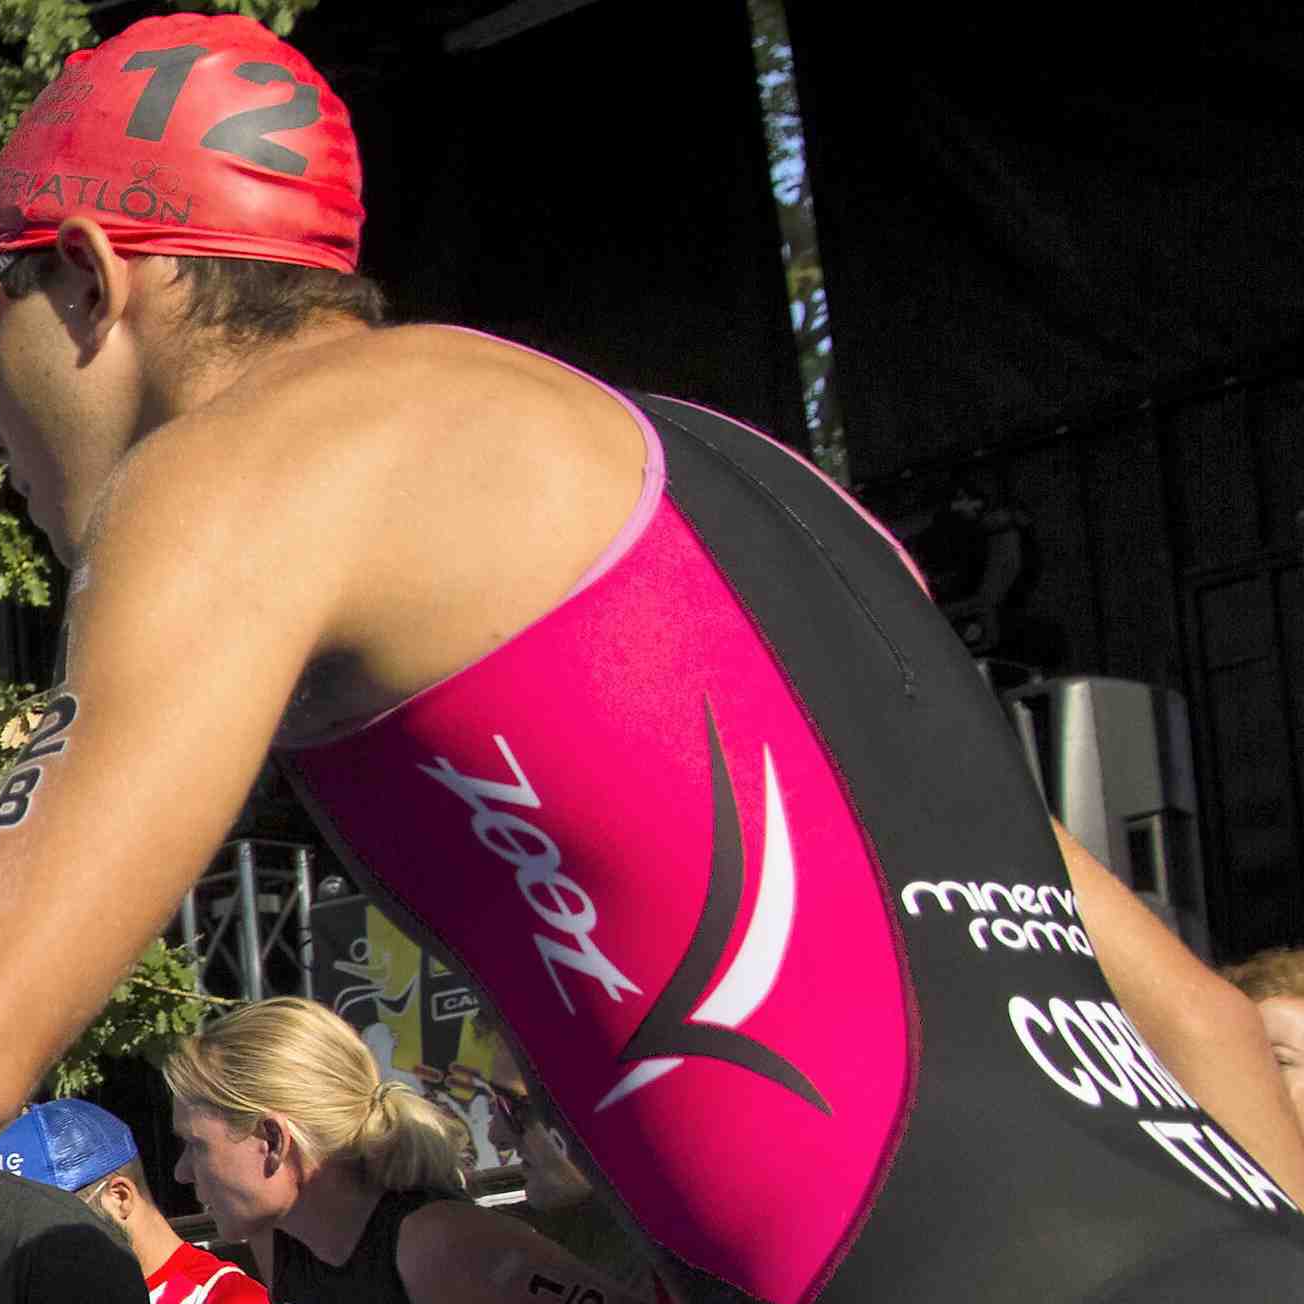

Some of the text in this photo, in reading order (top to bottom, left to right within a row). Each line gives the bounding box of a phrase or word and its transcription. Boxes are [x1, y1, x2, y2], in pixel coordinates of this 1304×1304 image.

[122, 44, 321, 175] 12
[901, 881, 1082, 915] minerv
[969, 917, 1094, 957] roma
[1138, 1120, 1300, 1210] ITA
